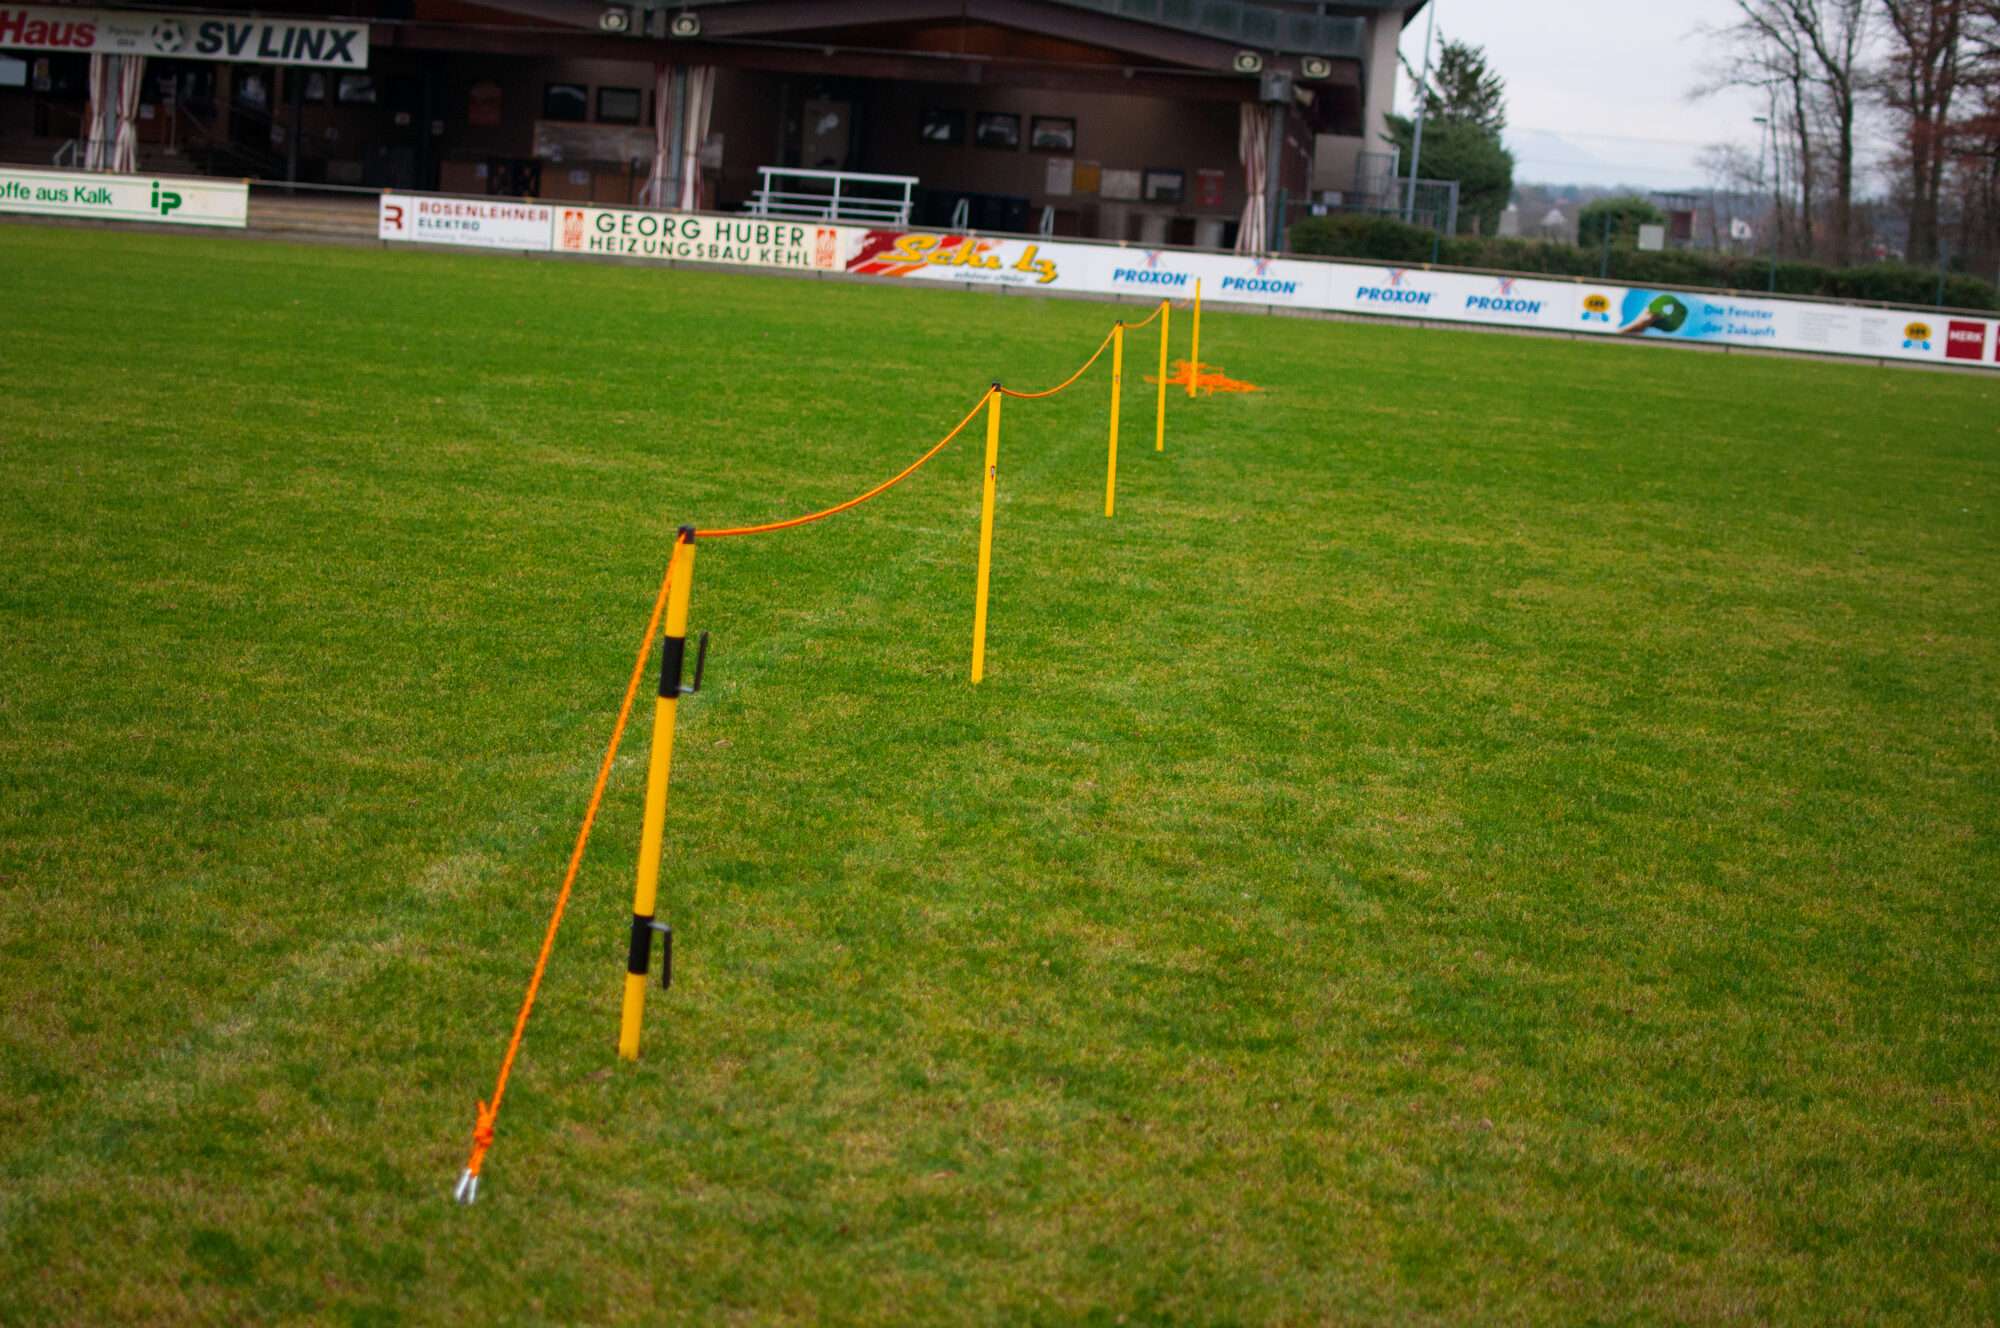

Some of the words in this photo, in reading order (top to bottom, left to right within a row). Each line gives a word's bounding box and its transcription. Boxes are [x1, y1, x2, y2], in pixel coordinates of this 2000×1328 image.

[0, 9, 97, 48] Haus
[195, 20, 253, 56] SV
[256, 26, 358, 63] LINX
[35, 186, 69, 202] aus
[73, 185, 113, 205] Kalk
[419, 201, 549, 221] ROSENLEHNER
[418, 218, 481, 231] ELEKTRO
[595, 213, 702, 240] GEORG
[714, 221, 805, 247] HUBER
[590, 236, 751, 262] HEIZUNGSBAU
[759, 249, 811, 267] KEHL
[1113, 267, 1187, 286] PROXON
[1221, 276, 1297, 294] PROXON
[1356, 286, 1432, 305] PROXON
[1465, 294, 1542, 314] PROXON
[1727, 304, 1775, 319] Fenster
[1727, 323, 1776, 338] Zukunft
